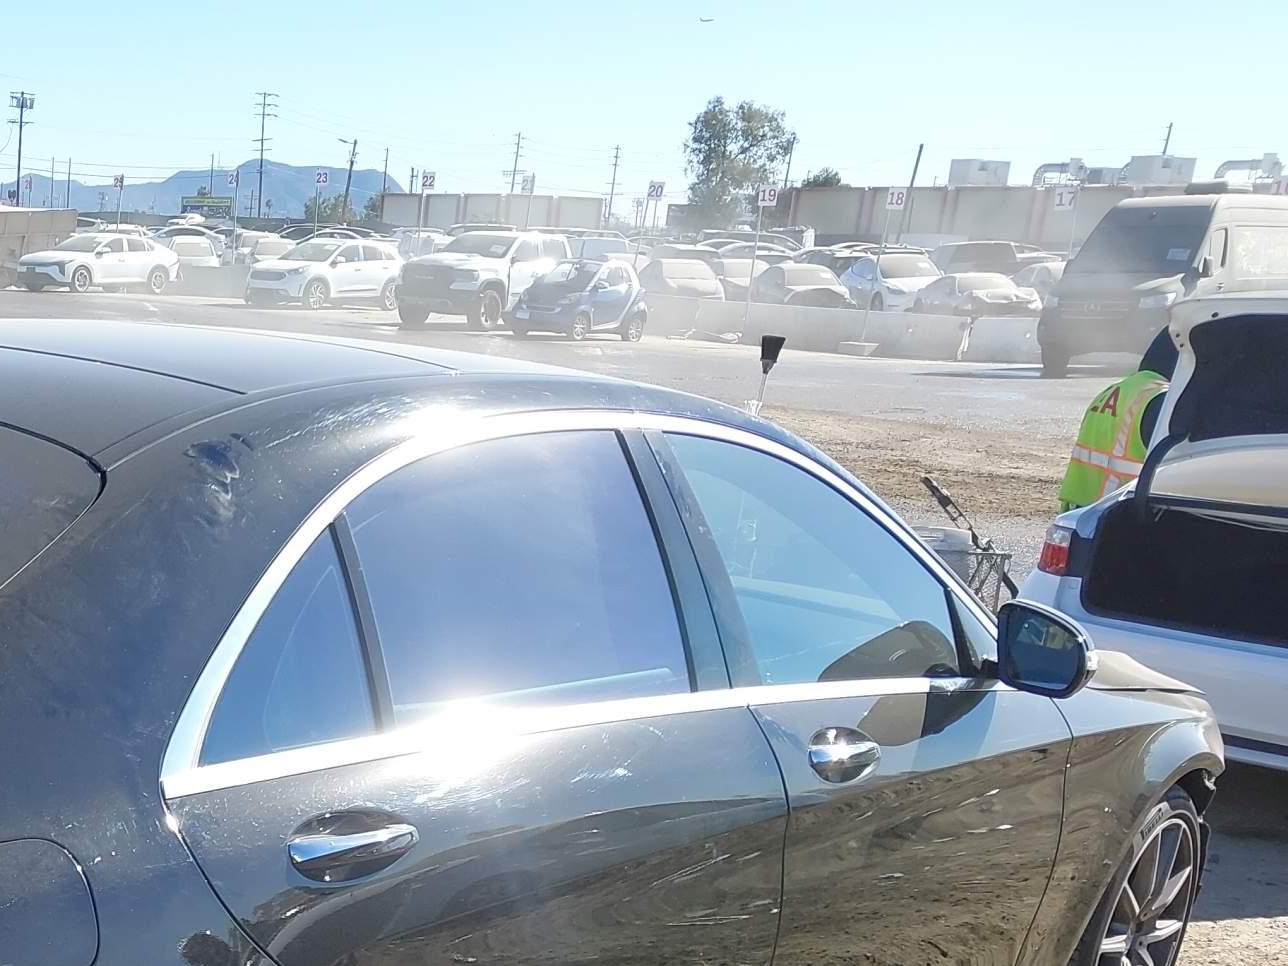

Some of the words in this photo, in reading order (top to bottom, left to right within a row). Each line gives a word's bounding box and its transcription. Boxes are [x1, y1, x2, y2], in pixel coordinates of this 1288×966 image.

[316, 172, 328, 184] 23
[422, 175, 435, 187] 22
[648, 184, 664, 198] 20
[760, 188, 777, 202] 19
[887, 191, 905, 206] 18
[1055, 191, 1075, 206] 17
